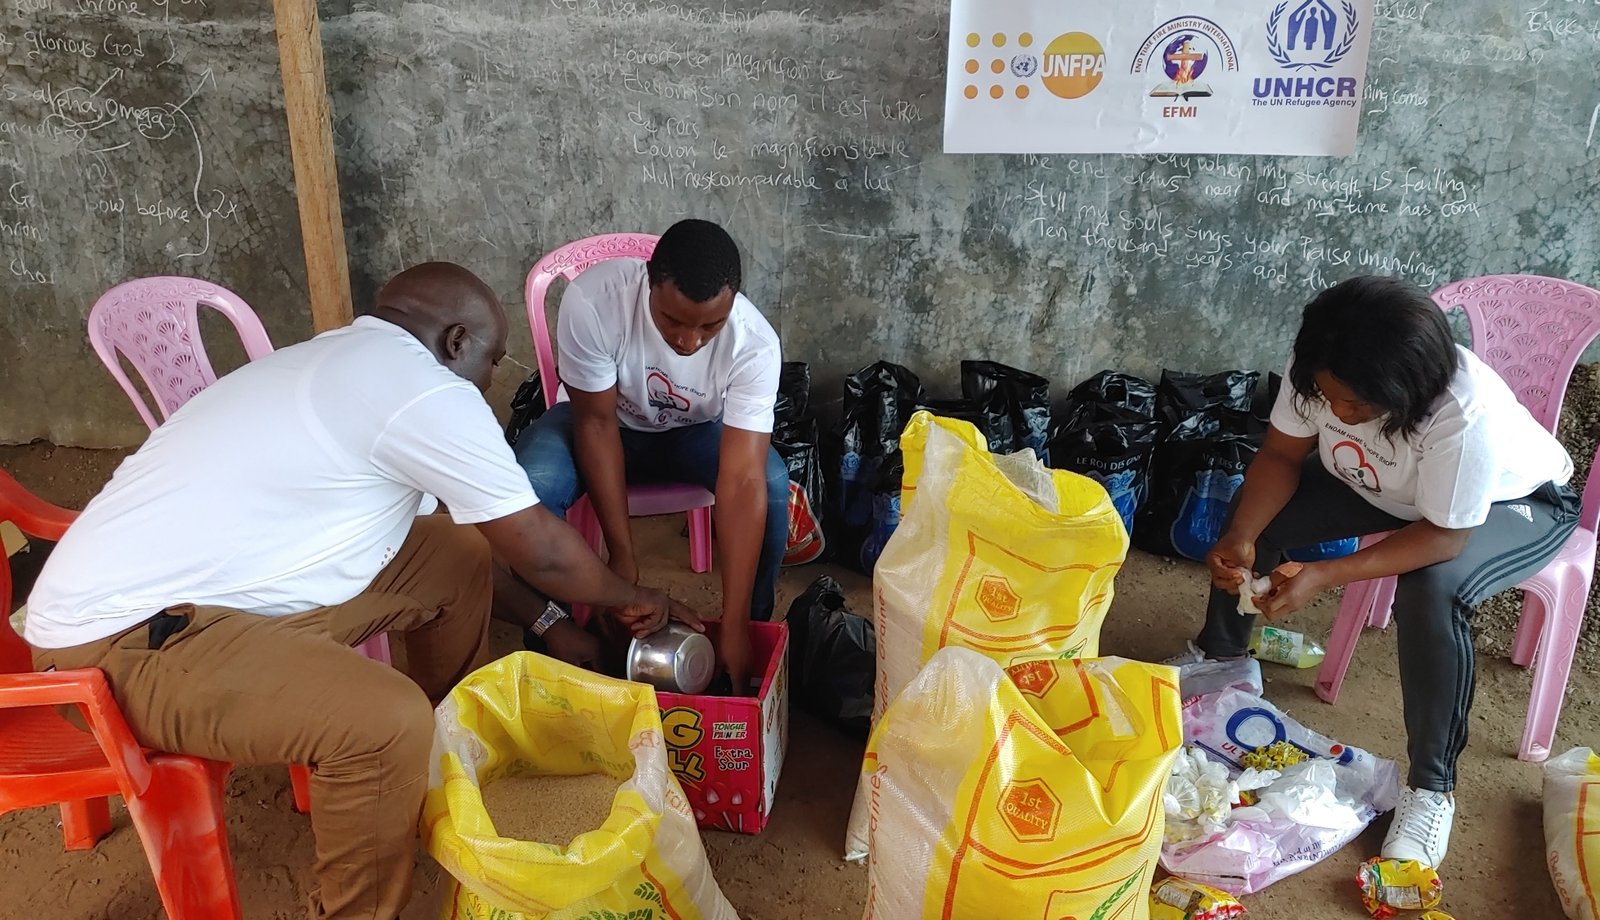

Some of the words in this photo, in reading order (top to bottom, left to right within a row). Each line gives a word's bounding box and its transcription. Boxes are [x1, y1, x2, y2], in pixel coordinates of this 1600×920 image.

[24, 30, 97, 60] glorious
[103, 33, 145, 57] God
[1134, 57, 1145, 73] END
[1140, 40, 1154, 59] TIME
[1152, 28, 1168, 42] FIRE
[1167, 20, 1202, 32] MINISTRY
[1202, 23, 1235, 72] INTERNATIONAL
[1040, 53, 1106, 78] UNFPA
[1252, 77, 1357, 98] UNHCR
[1163, 106, 1197, 118] EFMI
[1285, 99, 1321, 107] Refugee
[1323, 99, 1357, 108] Agency
[135, 188, 190, 225] before
[1205, 184, 1241, 198] near
[1257, 188, 1291, 207] and
[1345, 198, 1389, 215] time
[1030, 217, 1068, 241] Ten
[1253, 263, 1288, 284] and
[1324, 422, 1347, 437] ENDAM
[1346, 432, 1364, 445] HOME
[1076, 456, 1087, 466] LE
[1089, 458, 1108, 471] ROI
[1109, 460, 1126, 471] DES
[713, 722, 747, 731] TONGUE
[714, 746, 753, 760] Extra
[719, 758, 750, 771] Sour
[1020, 791, 1043, 811] 1st
[1006, 802, 1049, 830] QUALITY
